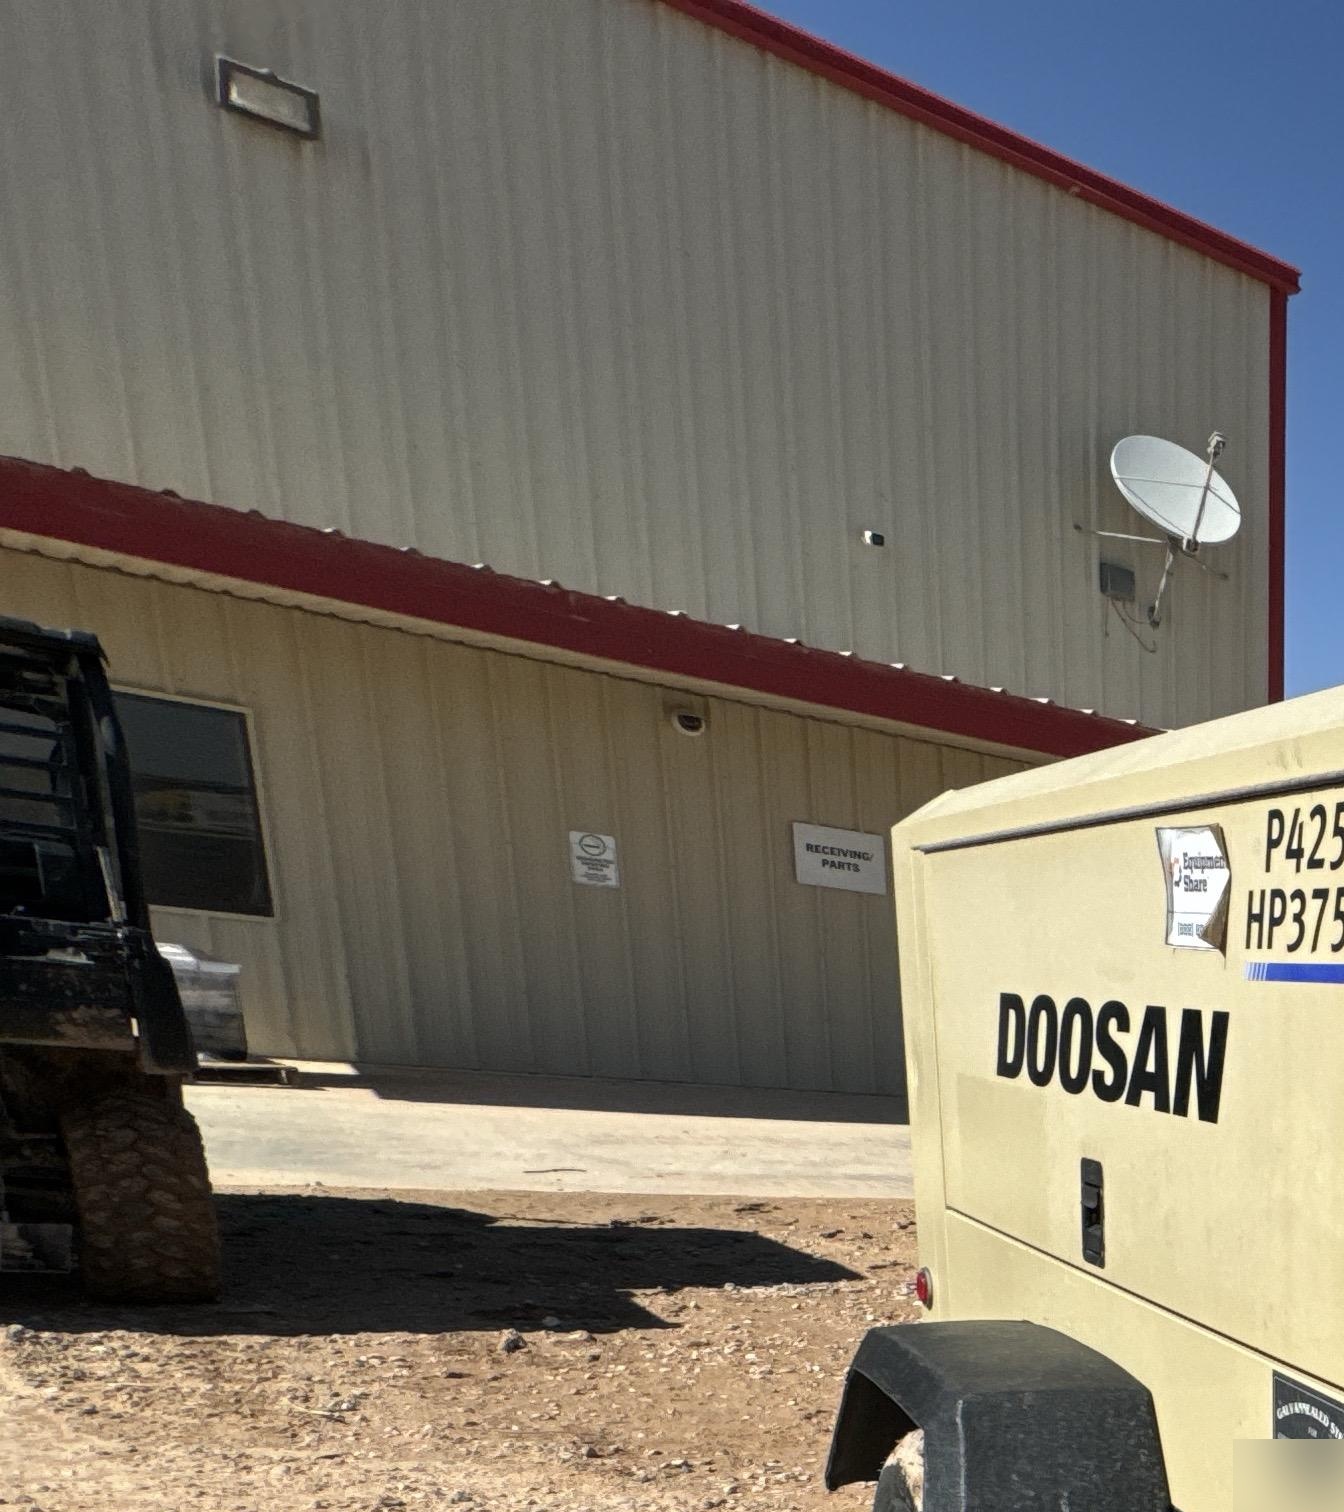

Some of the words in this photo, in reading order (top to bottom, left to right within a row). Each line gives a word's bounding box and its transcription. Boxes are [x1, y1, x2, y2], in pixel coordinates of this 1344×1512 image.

[805, 843, 874, 861] RECEIVING/
[821, 859, 861, 873] PARTS
[1183, 852, 1225, 874] Equipmen
[1184, 875, 1208, 892] Share
[997, 992, 1230, 1124] DOOSAN
